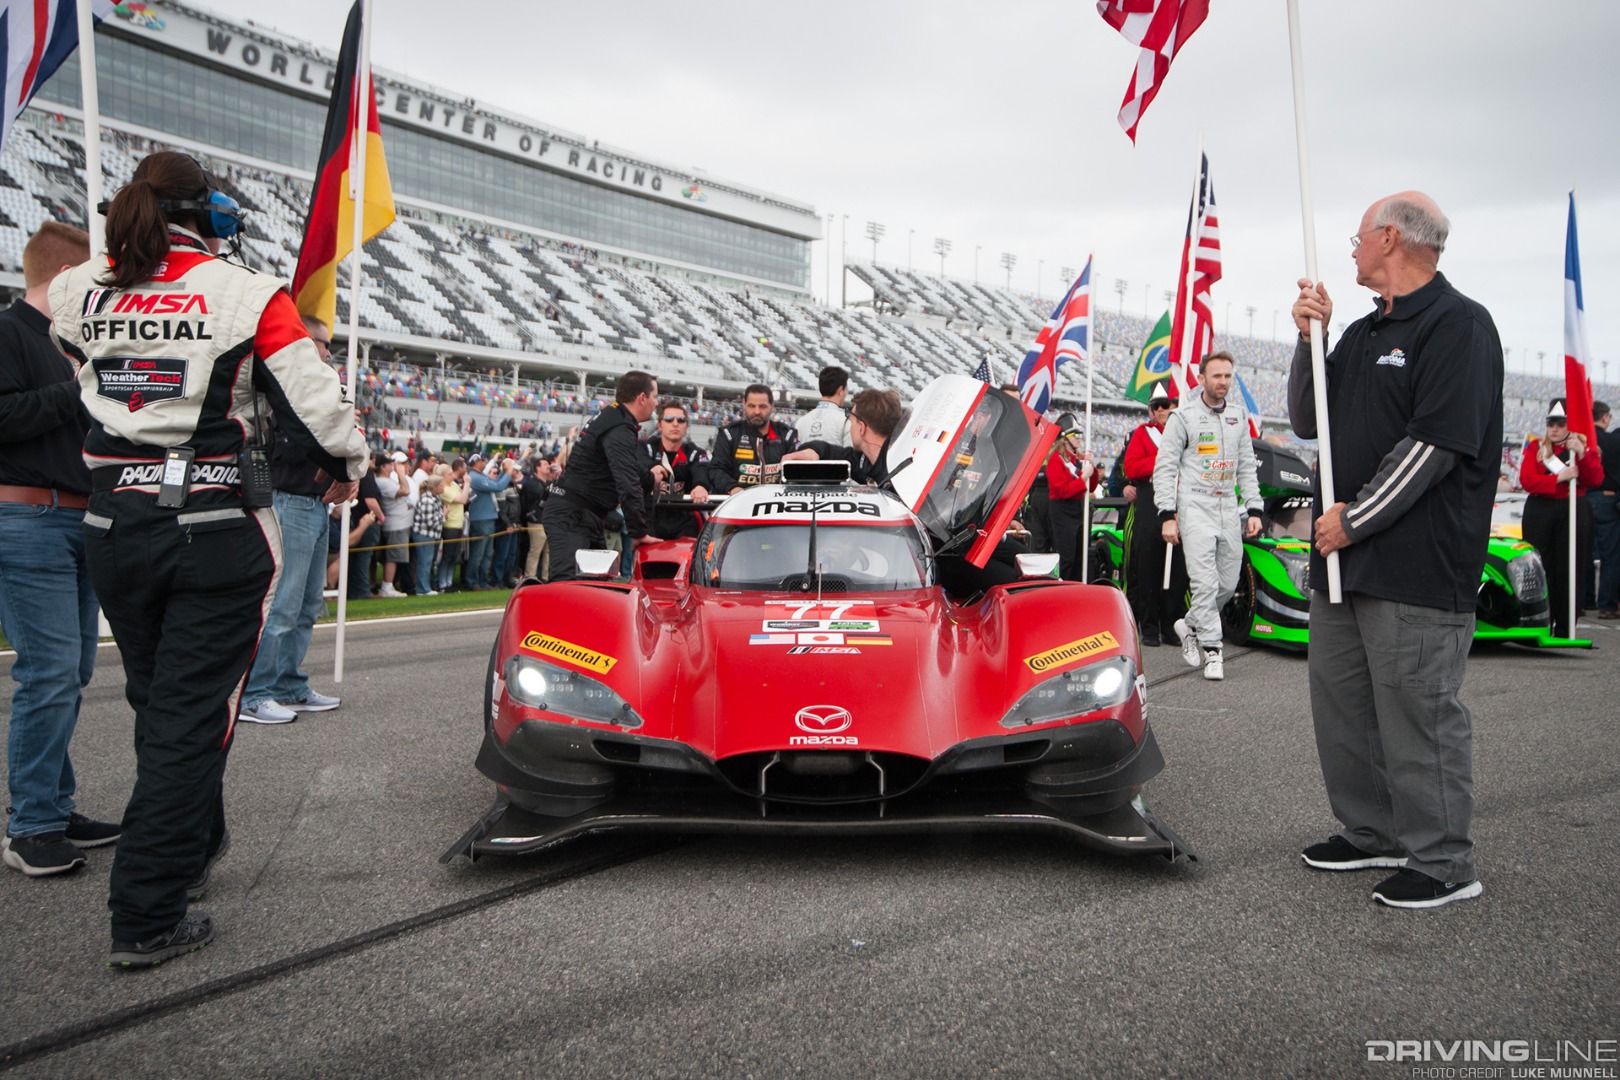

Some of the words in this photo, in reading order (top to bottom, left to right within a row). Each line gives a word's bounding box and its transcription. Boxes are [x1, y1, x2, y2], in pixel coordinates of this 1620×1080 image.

[519, 134, 551, 157] OF
[568, 149, 663, 192] RACING
[111, 293, 209, 315] IMSA
[81, 319, 213, 343] OFFICIAL
[132, 361, 157, 370] IMSA
[101, 373, 182, 384] WeatherTech
[117, 464, 163, 486] RACIN
[1280, 470, 1312, 486] ESM
[785, 603, 854, 620] 77
[524, 633, 602, 666] Continental
[1028, 636, 1105, 671] Continental
[789, 736, 859, 745] mazda
